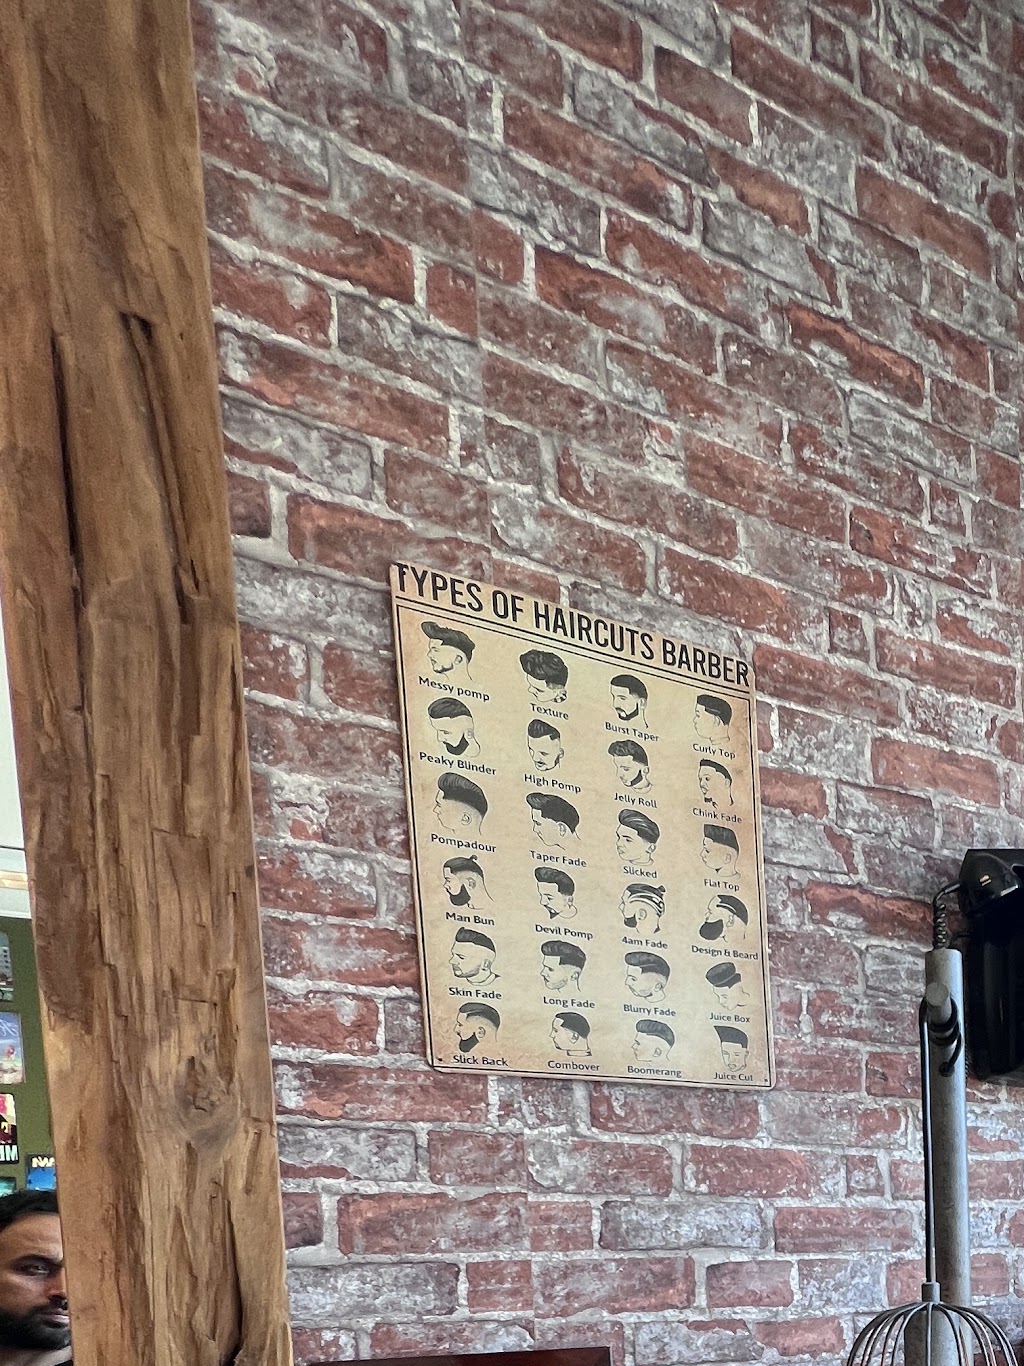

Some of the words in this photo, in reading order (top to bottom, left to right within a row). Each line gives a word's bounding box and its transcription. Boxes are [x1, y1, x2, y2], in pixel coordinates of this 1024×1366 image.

[392, 562, 484, 612] TYPES
[492, 589, 524, 622] OF
[534, 601, 655, 660] HAIRCUTS
[662, 638, 750, 687] BARBER
[418, 676, 453, 694] Messy
[457, 687, 490, 702] pomp
[530, 703, 569, 720] Texture
[605, 722, 630, 735] Burst
[632, 729, 660, 742] Taper
[692, 743, 717, 757] Curly
[719, 749, 736, 760] Top
[419, 752, 454, 768] Peaky
[457, 759, 497, 775] Blinder
[524, 774, 549, 787] High
[551, 779, 581, 794] Pomp
[614, 792, 636, 806] Jelly
[638, 797, 658, 808] Roll
[692, 808, 718, 820] Chink
[721, 813, 743, 824] Fade
[431, 833, 497, 853] Pompadour
[529, 850, 559, 863] Taper
[562, 856, 587, 868] Fade
[623, 866, 658, 879] Slicked
[703, 878, 721, 889] Flat
[723, 881, 740, 892] Top
[445, 911, 471, 924] Man
[473, 915, 495, 926] Bun
[535, 924, 562, 936] Devil
[564, 928, 593, 941] Pomp
[622, 936, 643, 947] 4am
[645, 939, 669, 950] Fade
[691, 945, 722, 958] Design
[723, 949, 731, 958] &
[733, 949, 759, 961] Beard
[449, 987, 473, 998] Skin
[475, 989, 502, 1000] Fade
[543, 996, 569, 1009] Long
[571, 998, 596, 1009] Fade
[623, 1004, 652, 1016] Blurry
[654, 1008, 676, 1017] Fade
[709, 1012, 732, 1022] Juice
[734, 1014, 751, 1024] Box
[453, 1055, 479, 1066] Slick
[481, 1057, 509, 1068] Back
[547, 1061, 600, 1072] Combover
[627, 1065, 683, 1079] Boomerang
[714, 1072, 737, 1081] Juice
[738, 1074, 754, 1082] Cut
